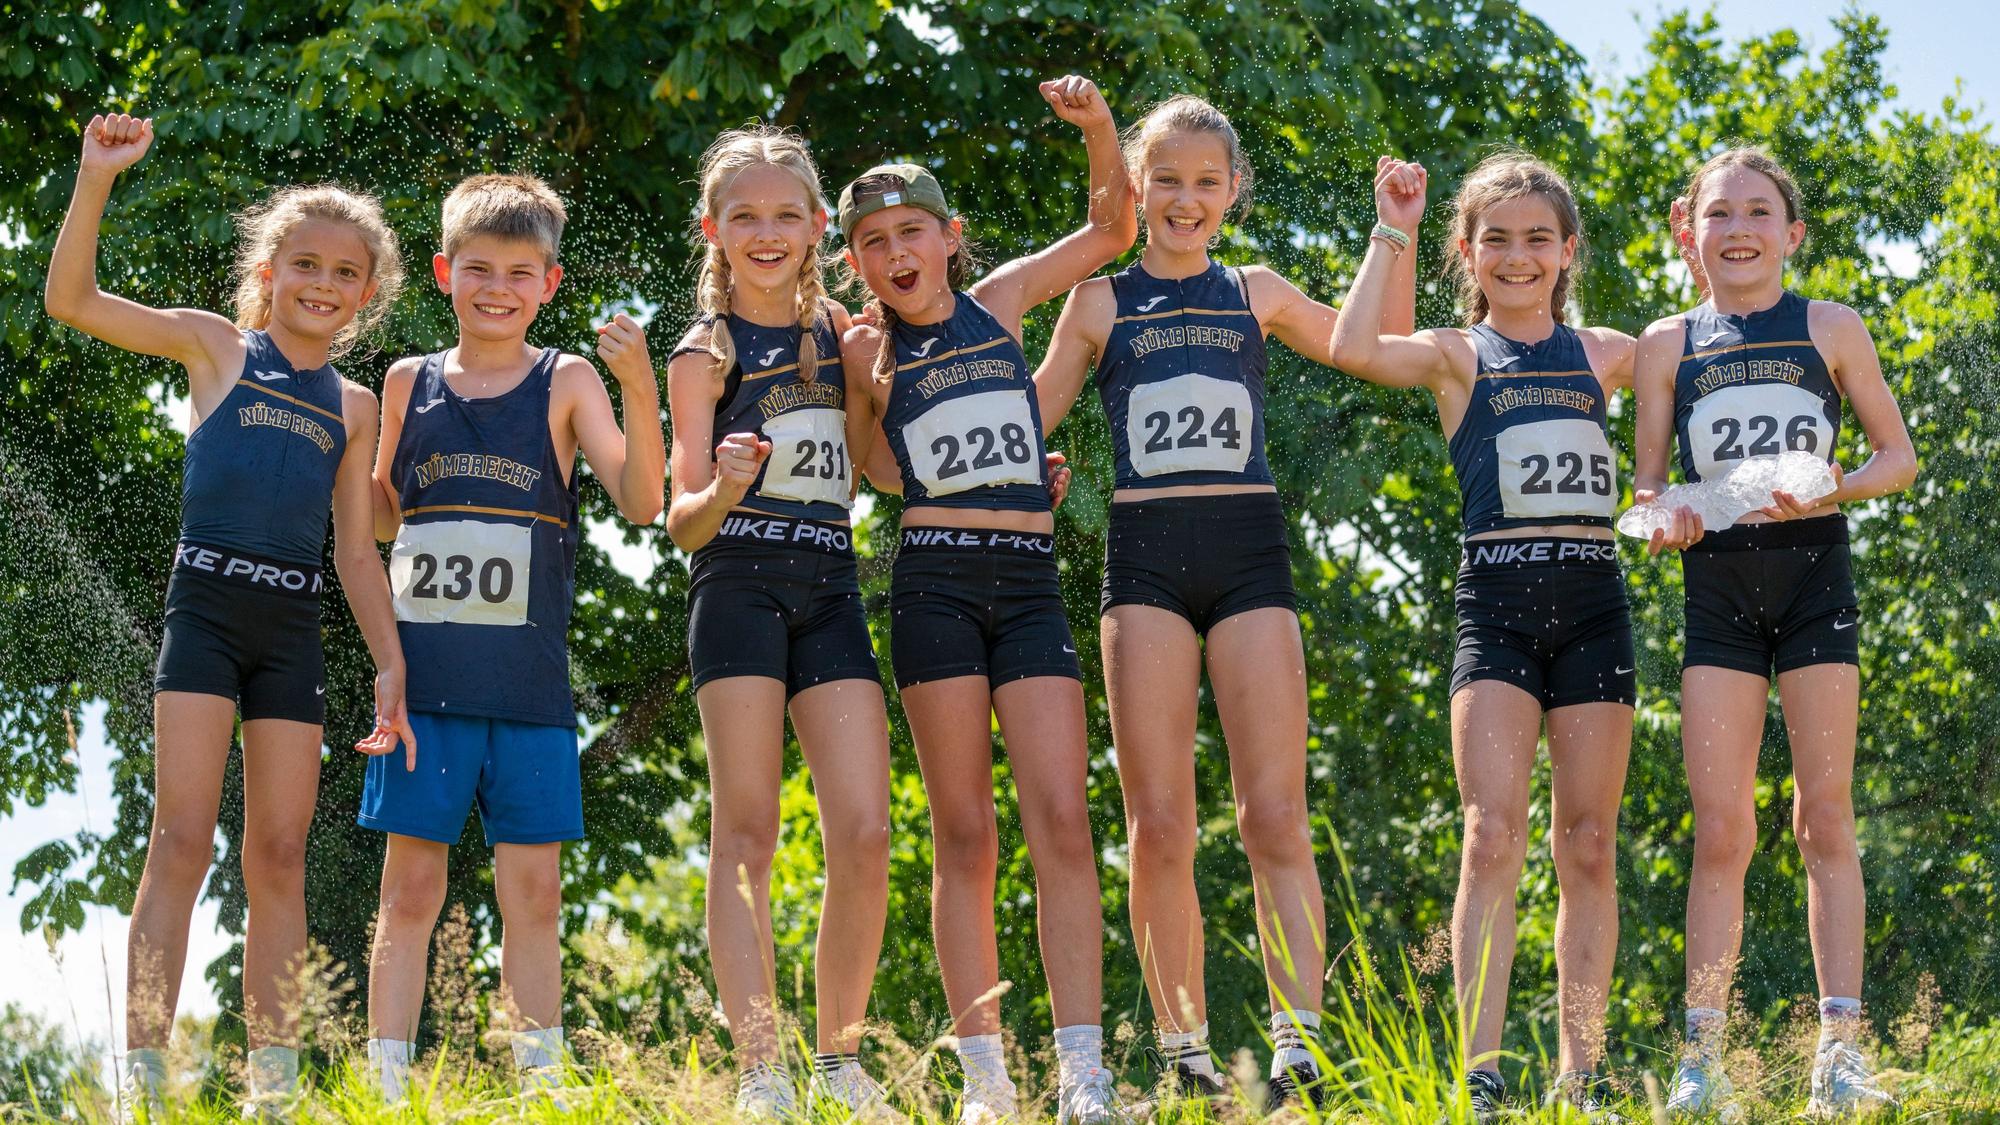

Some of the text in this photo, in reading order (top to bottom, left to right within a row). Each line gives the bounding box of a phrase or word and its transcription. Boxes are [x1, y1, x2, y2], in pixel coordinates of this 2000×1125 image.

[930, 422, 1031, 481] 228
[1144, 405, 1241, 455] 224
[1711, 414, 1818, 462] 226
[414, 453, 542, 492] NÜMBRECHT
[789, 439, 846, 481] 231
[1520, 451, 1611, 497] 225
[792, 523, 848, 551] PRO
[1473, 542, 1554, 566] NIKE
[1558, 542, 1616, 561] PRO
[223, 557, 306, 591] PRO
[413, 553, 514, 604] 230
